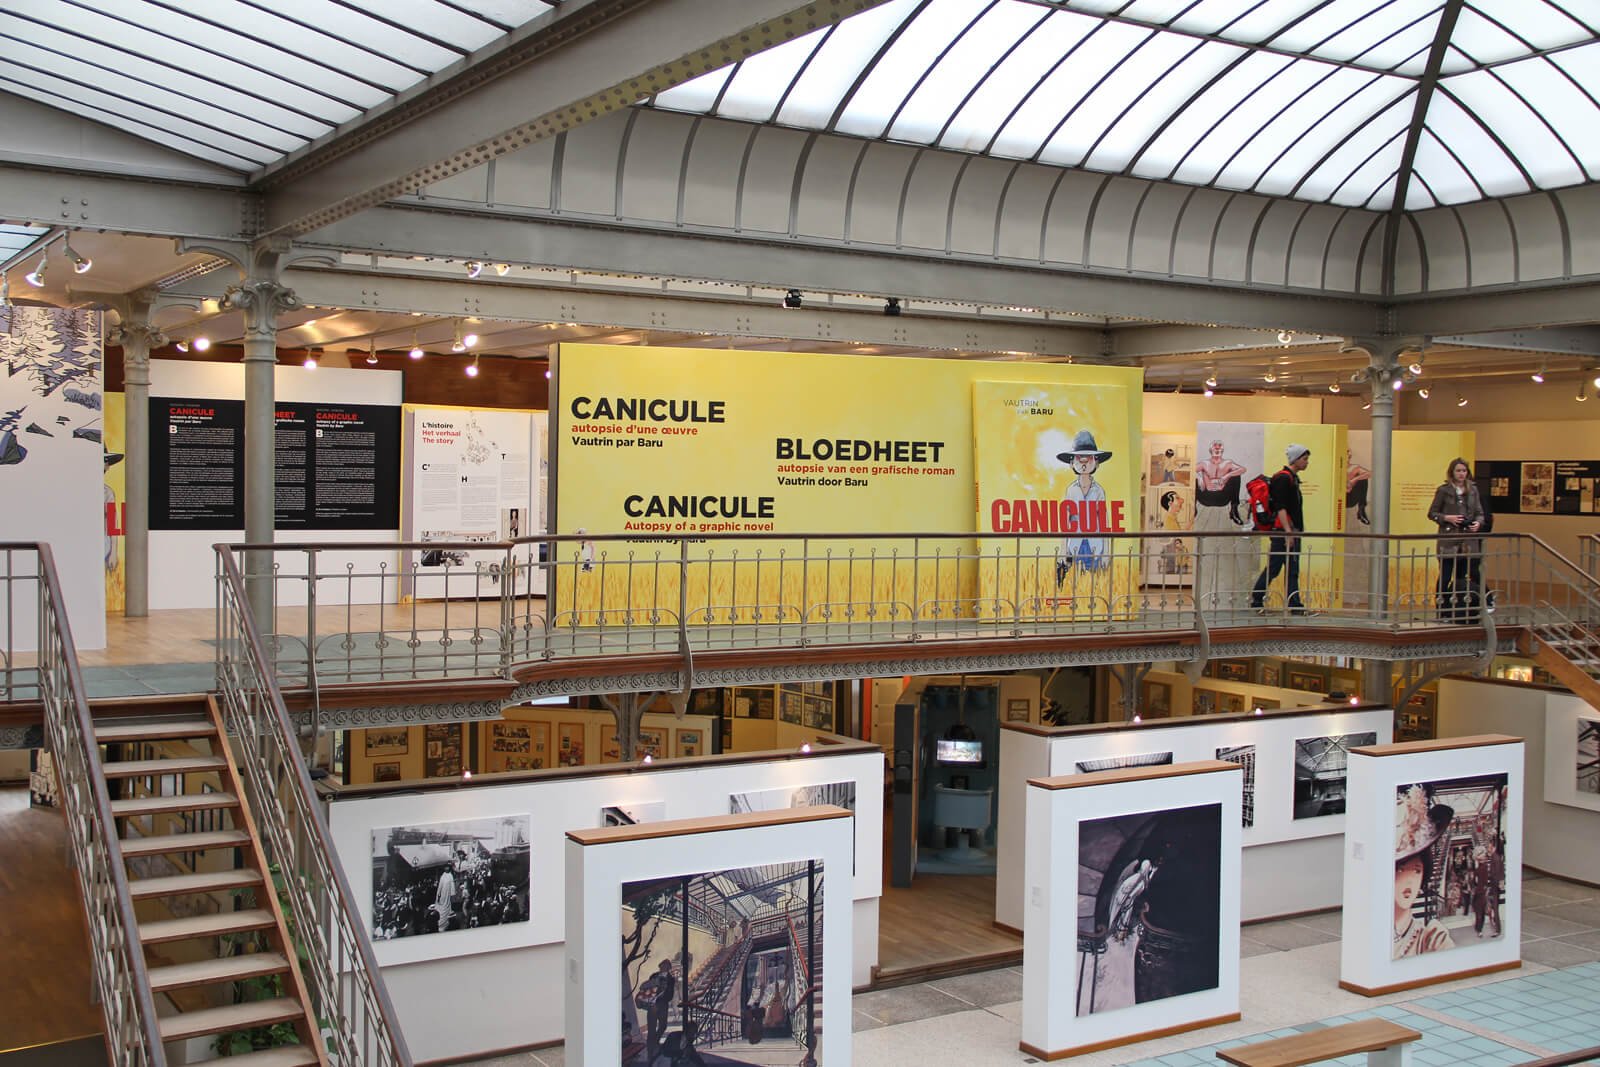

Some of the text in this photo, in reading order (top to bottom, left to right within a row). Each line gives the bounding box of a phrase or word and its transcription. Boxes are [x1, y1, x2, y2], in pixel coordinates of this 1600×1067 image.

[169, 408, 215, 416] CANICULE
[571, 396, 726, 423] CANICULE
[1031, 408, 1054, 416] BARU
[315, 412, 358, 421] CANICULE
[571, 424, 698, 436] autopsie d'une œuvre
[436, 437, 454, 445] story
[572, 436, 663, 449] Vautrin par Baru
[776, 438, 944, 463] BLOEDHEET
[777, 464, 955, 477] autopsie van een grafische roman
[777, 476, 868, 487] Vautrin door Baru
[624, 495, 775, 518] CANICULE
[991, 498, 1126, 534] CANICULE
[624, 521, 774, 534] Autopsy of a graphic novel
